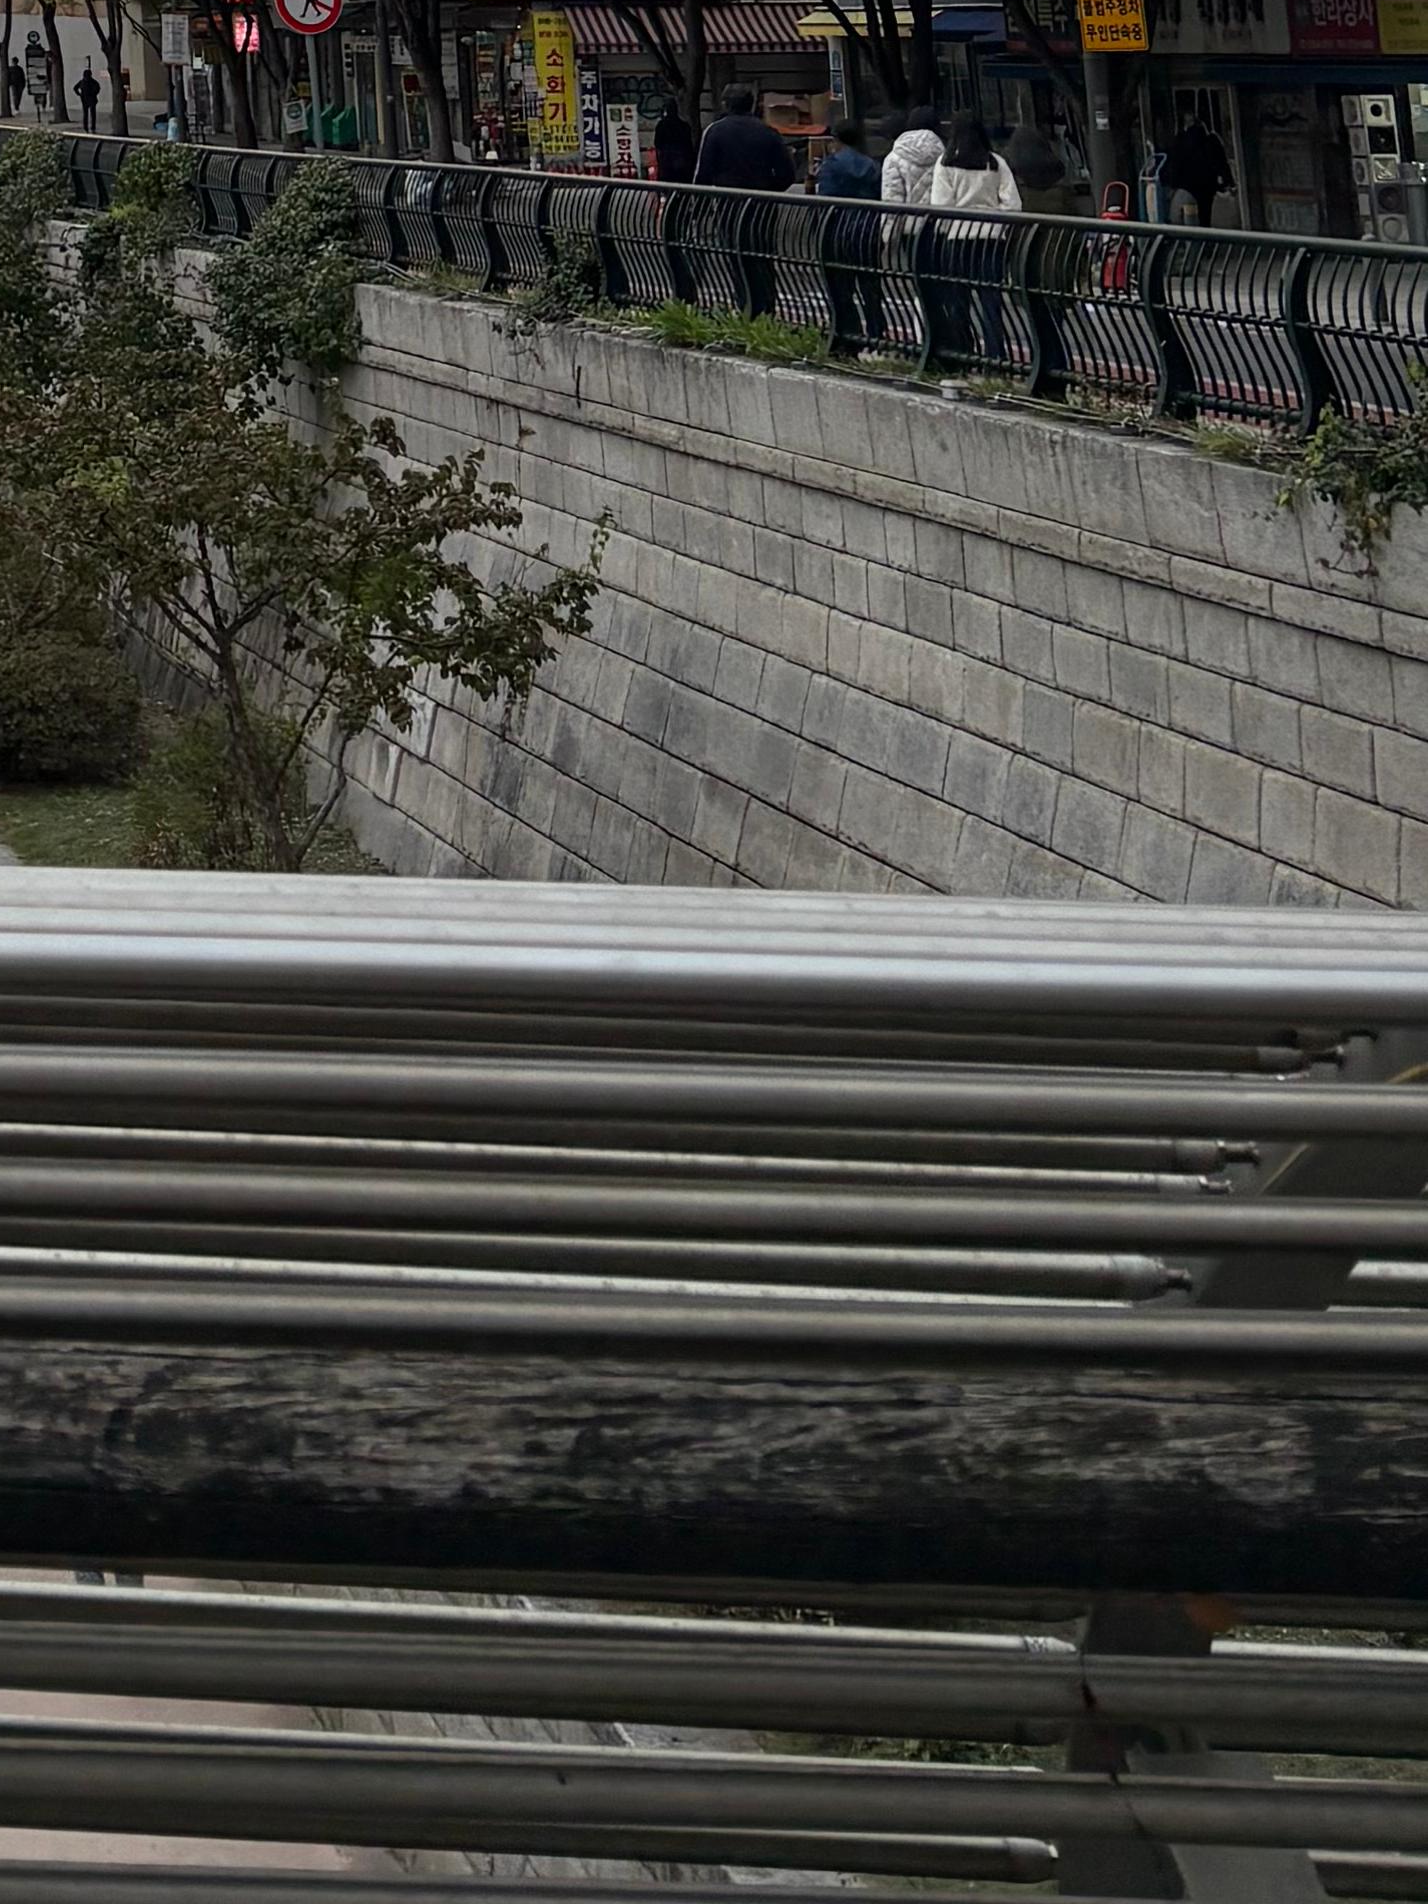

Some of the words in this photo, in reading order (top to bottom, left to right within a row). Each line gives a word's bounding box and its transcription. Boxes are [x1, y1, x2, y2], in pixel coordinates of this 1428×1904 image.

[1087, 23, 1143, 43] 무인단속중
[546, 48, 568, 122] 소화기
[580, 70, 601, 160] 주차가능
